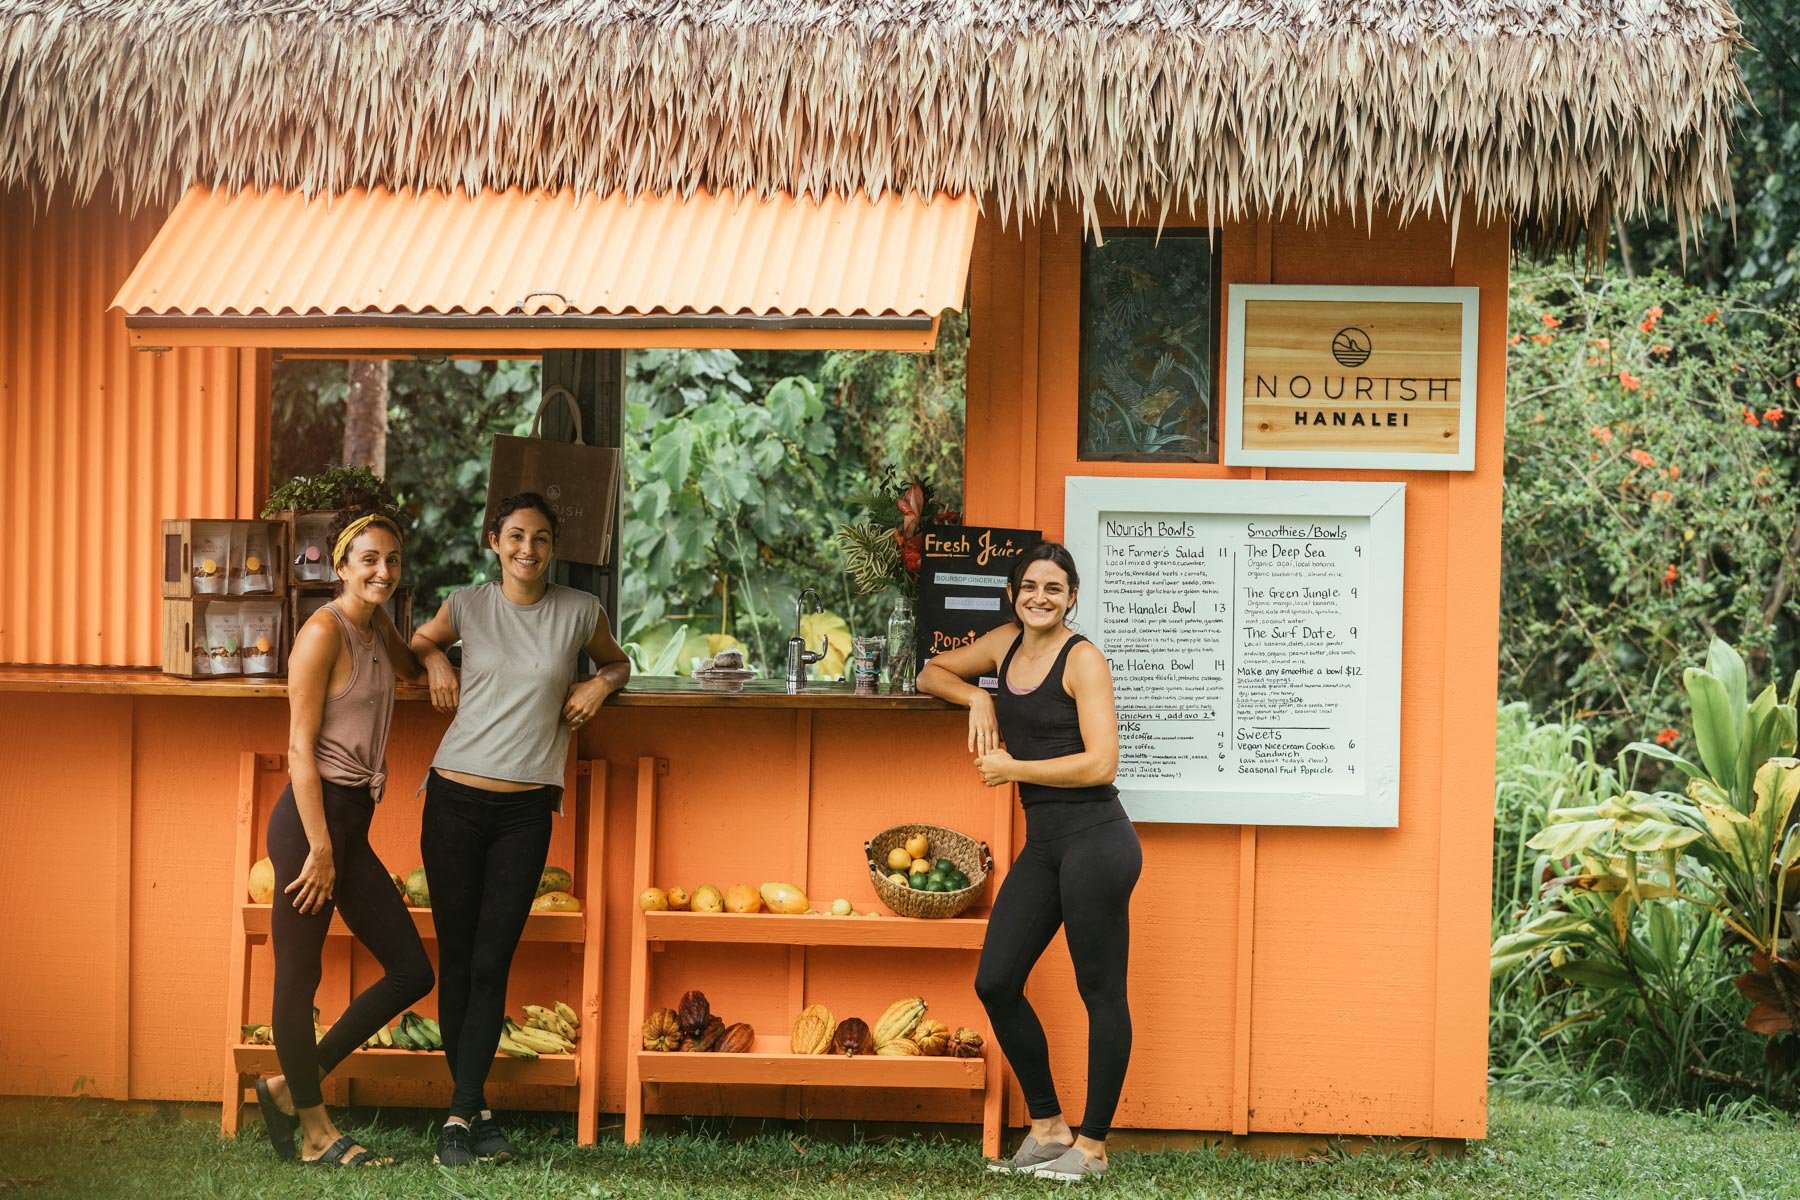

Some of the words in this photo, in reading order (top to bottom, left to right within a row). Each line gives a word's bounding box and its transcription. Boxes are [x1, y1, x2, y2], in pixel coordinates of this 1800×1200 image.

[1256, 375, 1448, 401] NOURISH
[1294, 411, 1408, 427] HANALEI
[552, 504, 583, 517] RISH
[1106, 520, 1152, 537] Nourish
[1158, 520, 1195, 537] Bowls
[1247, 522, 1348, 538] Smoothies/Bowls
[925, 533, 970, 552] Fresh
[1104, 544, 1125, 557] The
[1128, 544, 1169, 558] Farmer's
[1175, 545, 1205, 558] Salad
[1219, 547, 1227, 558] 11
[1243, 544, 1268, 557] The
[1272, 543, 1300, 559] Deep
[1304, 543, 1327, 558] Sea
[1354, 545, 1361, 558] 9
[1247, 559, 1273, 569] Organic
[936, 575, 967, 583] SOURSOP
[1243, 587, 1265, 598] The
[1269, 587, 1299, 599] Green
[1302, 587, 1341, 599] Jungle
[1350, 587, 1357, 599] 9
[1102, 601, 1126, 614] The
[1128, 602, 1167, 614] Hanalei
[1172, 600, 1195, 614] Bowl
[1214, 603, 1226, 613] 13
[1247, 600, 1271, 609] Organic
[1242, 627, 1267, 639] The
[1271, 626, 1298, 639] Surf
[1303, 626, 1336, 639] Date
[1349, 626, 1358, 639] 9
[933, 630, 976, 650] Popsi
[1107, 658, 1124, 671] The
[1171, 658, 1194, 671] Bowl
[1215, 659, 1225, 671] 14
[1237, 667, 1262, 675] Make
[1265, 667, 1280, 677] any
[1280, 666, 1314, 675] smoothie
[1326, 666, 1343, 675] bowl
[1344, 665, 1363, 677] $12
[1120, 712, 1152, 720] chicken
[1117, 721, 1141, 731] inks
[1236, 728, 1282, 740] Sweets
[1305, 742, 1336, 750] Cookie
[1348, 739, 1356, 749] 6
[1254, 749, 1300, 758] Sandwich
[1217, 764, 1224, 772] 6
[1238, 765, 1278, 774] Seasonal
[1279, 765, 1297, 774] Fruit
[1300, 765, 1334, 776] Popsicle
[1348, 765, 1355, 775] 4
